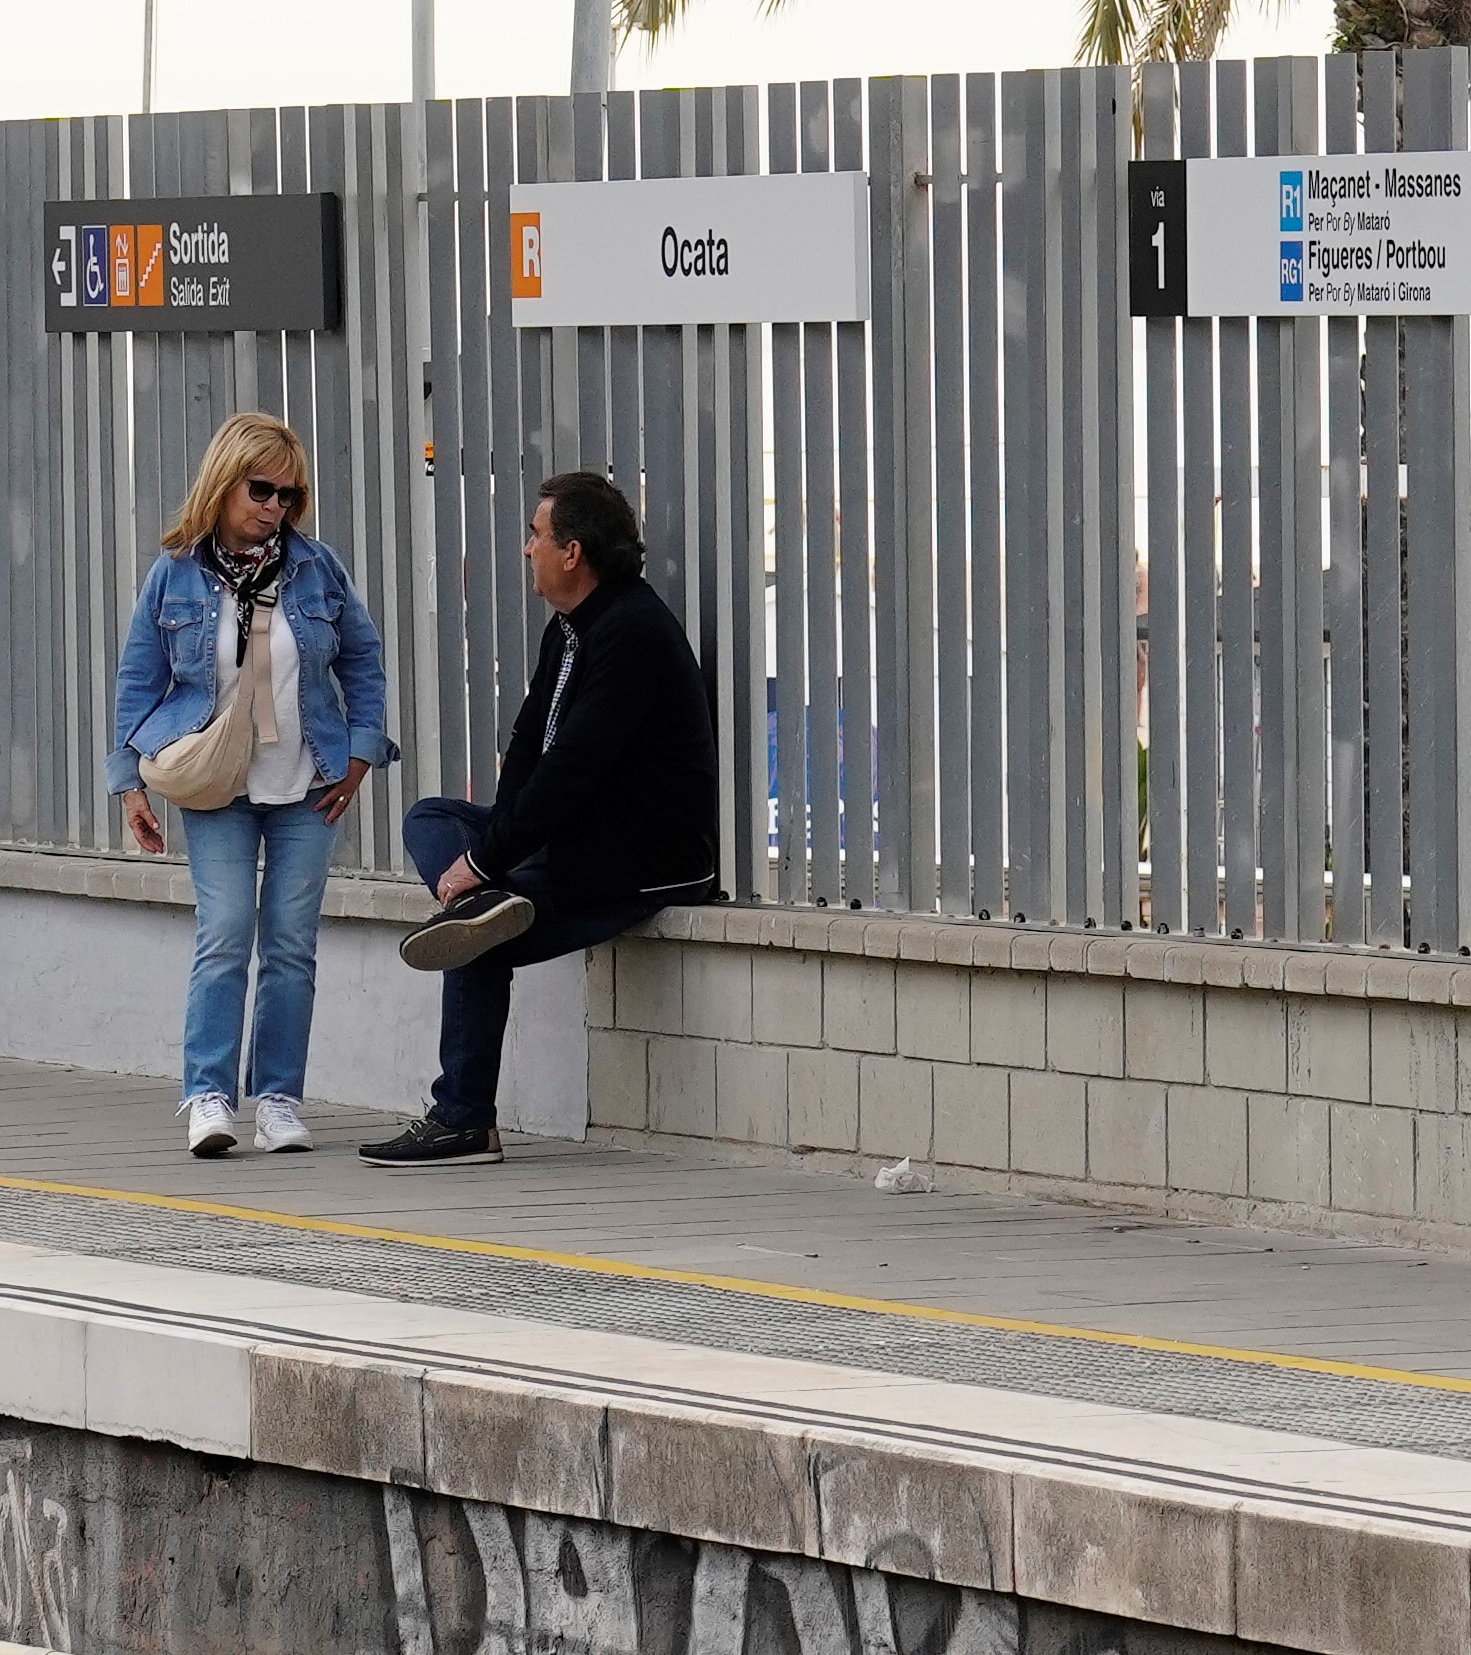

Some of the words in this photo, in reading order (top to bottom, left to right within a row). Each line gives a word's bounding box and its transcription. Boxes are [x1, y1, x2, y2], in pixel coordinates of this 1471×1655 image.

[1151, 185, 1165, 208] via
[1282, 185, 1302, 219] R1
[1308, 169, 1370, 207] Maçanet
[1385, 168, 1461, 199] Massanes
[1309, 214, 1324, 231] Per
[1326, 213, 1342, 230] Por
[1343, 213, 1355, 235] By
[1357, 209, 1391, 231] Mataró
[169, 222, 230, 265] Sortida
[521, 224, 542, 278] R
[660, 225, 730, 280] Ocata
[1151, 222, 1166, 290] 1
[1308, 239, 1373, 278] Figueres
[1376, 241, 1383, 270] /
[1386, 238, 1446, 270] Portbou
[1281, 258, 1302, 285] RG1
[170, 276, 204, 307] Salida
[208, 276, 230, 307] Exit
[1309, 283, 1324, 302] Per
[1326, 283, 1342, 301] Por
[1343, 283, 1355, 306] By
[1357, 280, 1391, 302] Mataró
[1393, 281, 1397, 301] i
[1399, 280, 1431, 302] Girona
